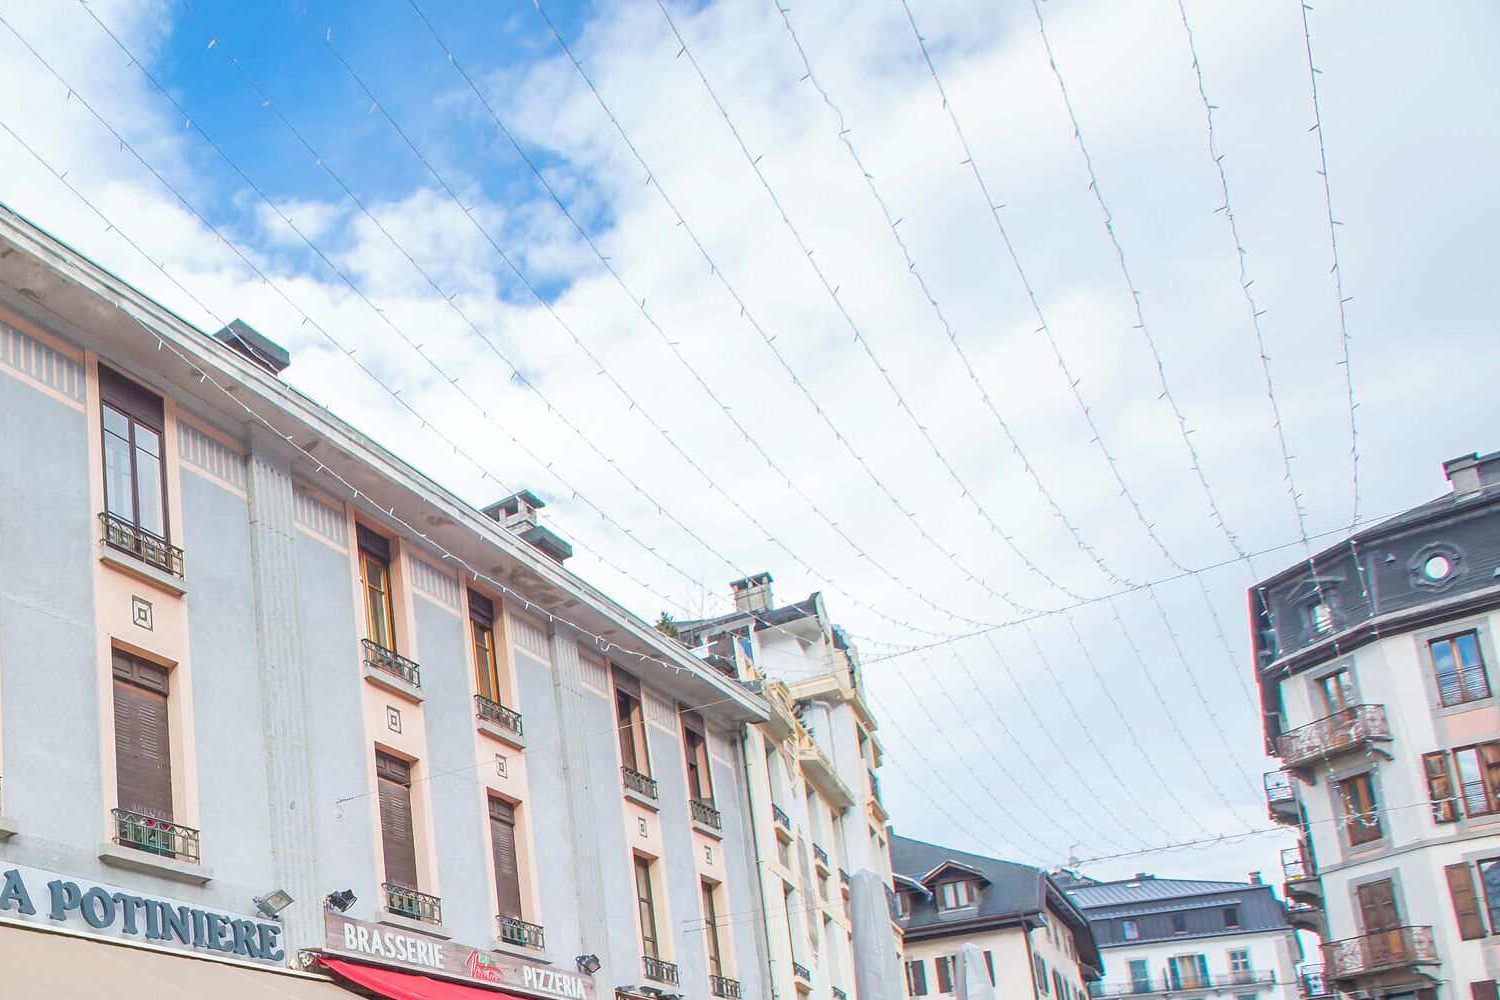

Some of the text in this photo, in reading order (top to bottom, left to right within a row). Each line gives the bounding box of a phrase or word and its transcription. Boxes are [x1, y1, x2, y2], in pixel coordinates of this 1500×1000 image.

[47, 879, 285, 961] POTINIERE
[343, 921, 445, 970] BRASSERIE
[522, 965, 587, 1000] PIZZERIA
